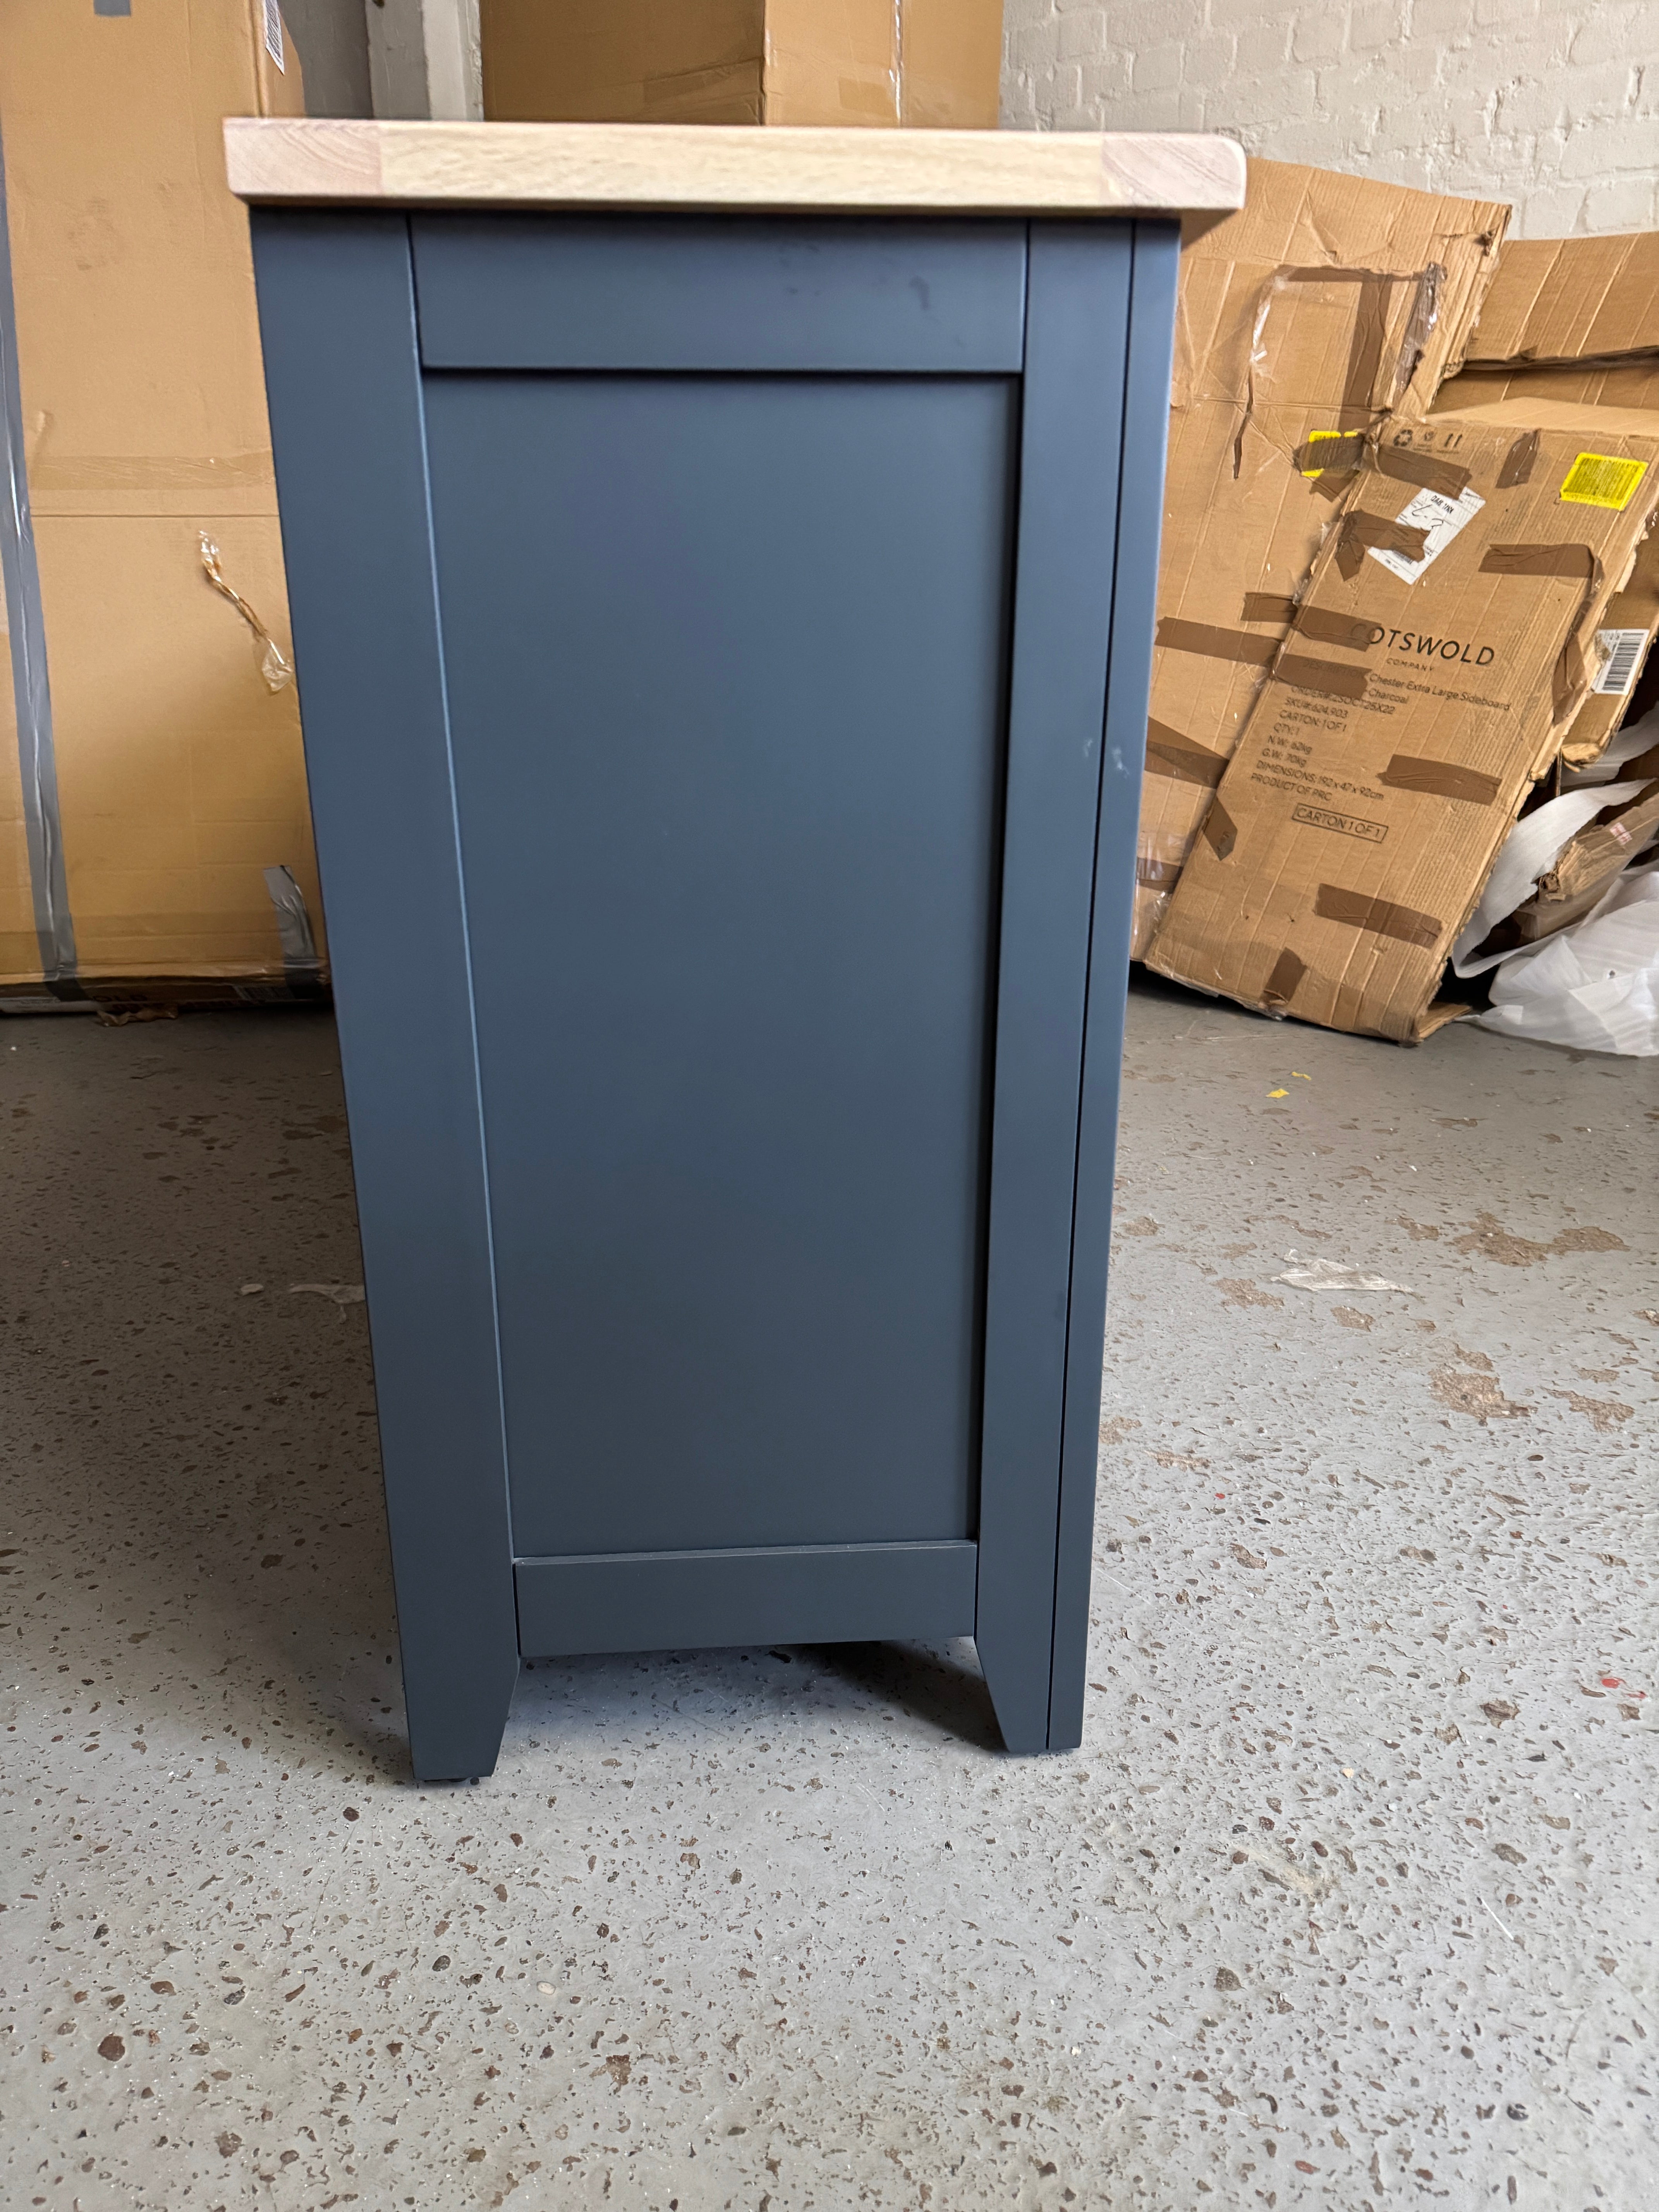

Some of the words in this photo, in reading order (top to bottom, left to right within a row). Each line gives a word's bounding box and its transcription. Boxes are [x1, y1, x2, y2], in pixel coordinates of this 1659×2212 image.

[1386, 658, 1434, 671] COMPANY
[1370, 673, 1404, 688] Chester
[1407, 681, 1430, 693] Extra
[1432, 686, 1459, 700] Large
[1460, 692, 1511, 711] Sideboard
[1257, 760, 1316, 783] DIMENSIONS:
[1286, 753, 1307, 768] 70kg
[1251, 773, 1297, 791] PRODUCT
[1297, 785, 1312, 795] OF
[1312, 788, 1333, 801] PRC
[1297, 807, 1347, 830] CARTON
[1355, 823, 1373, 835] OF
